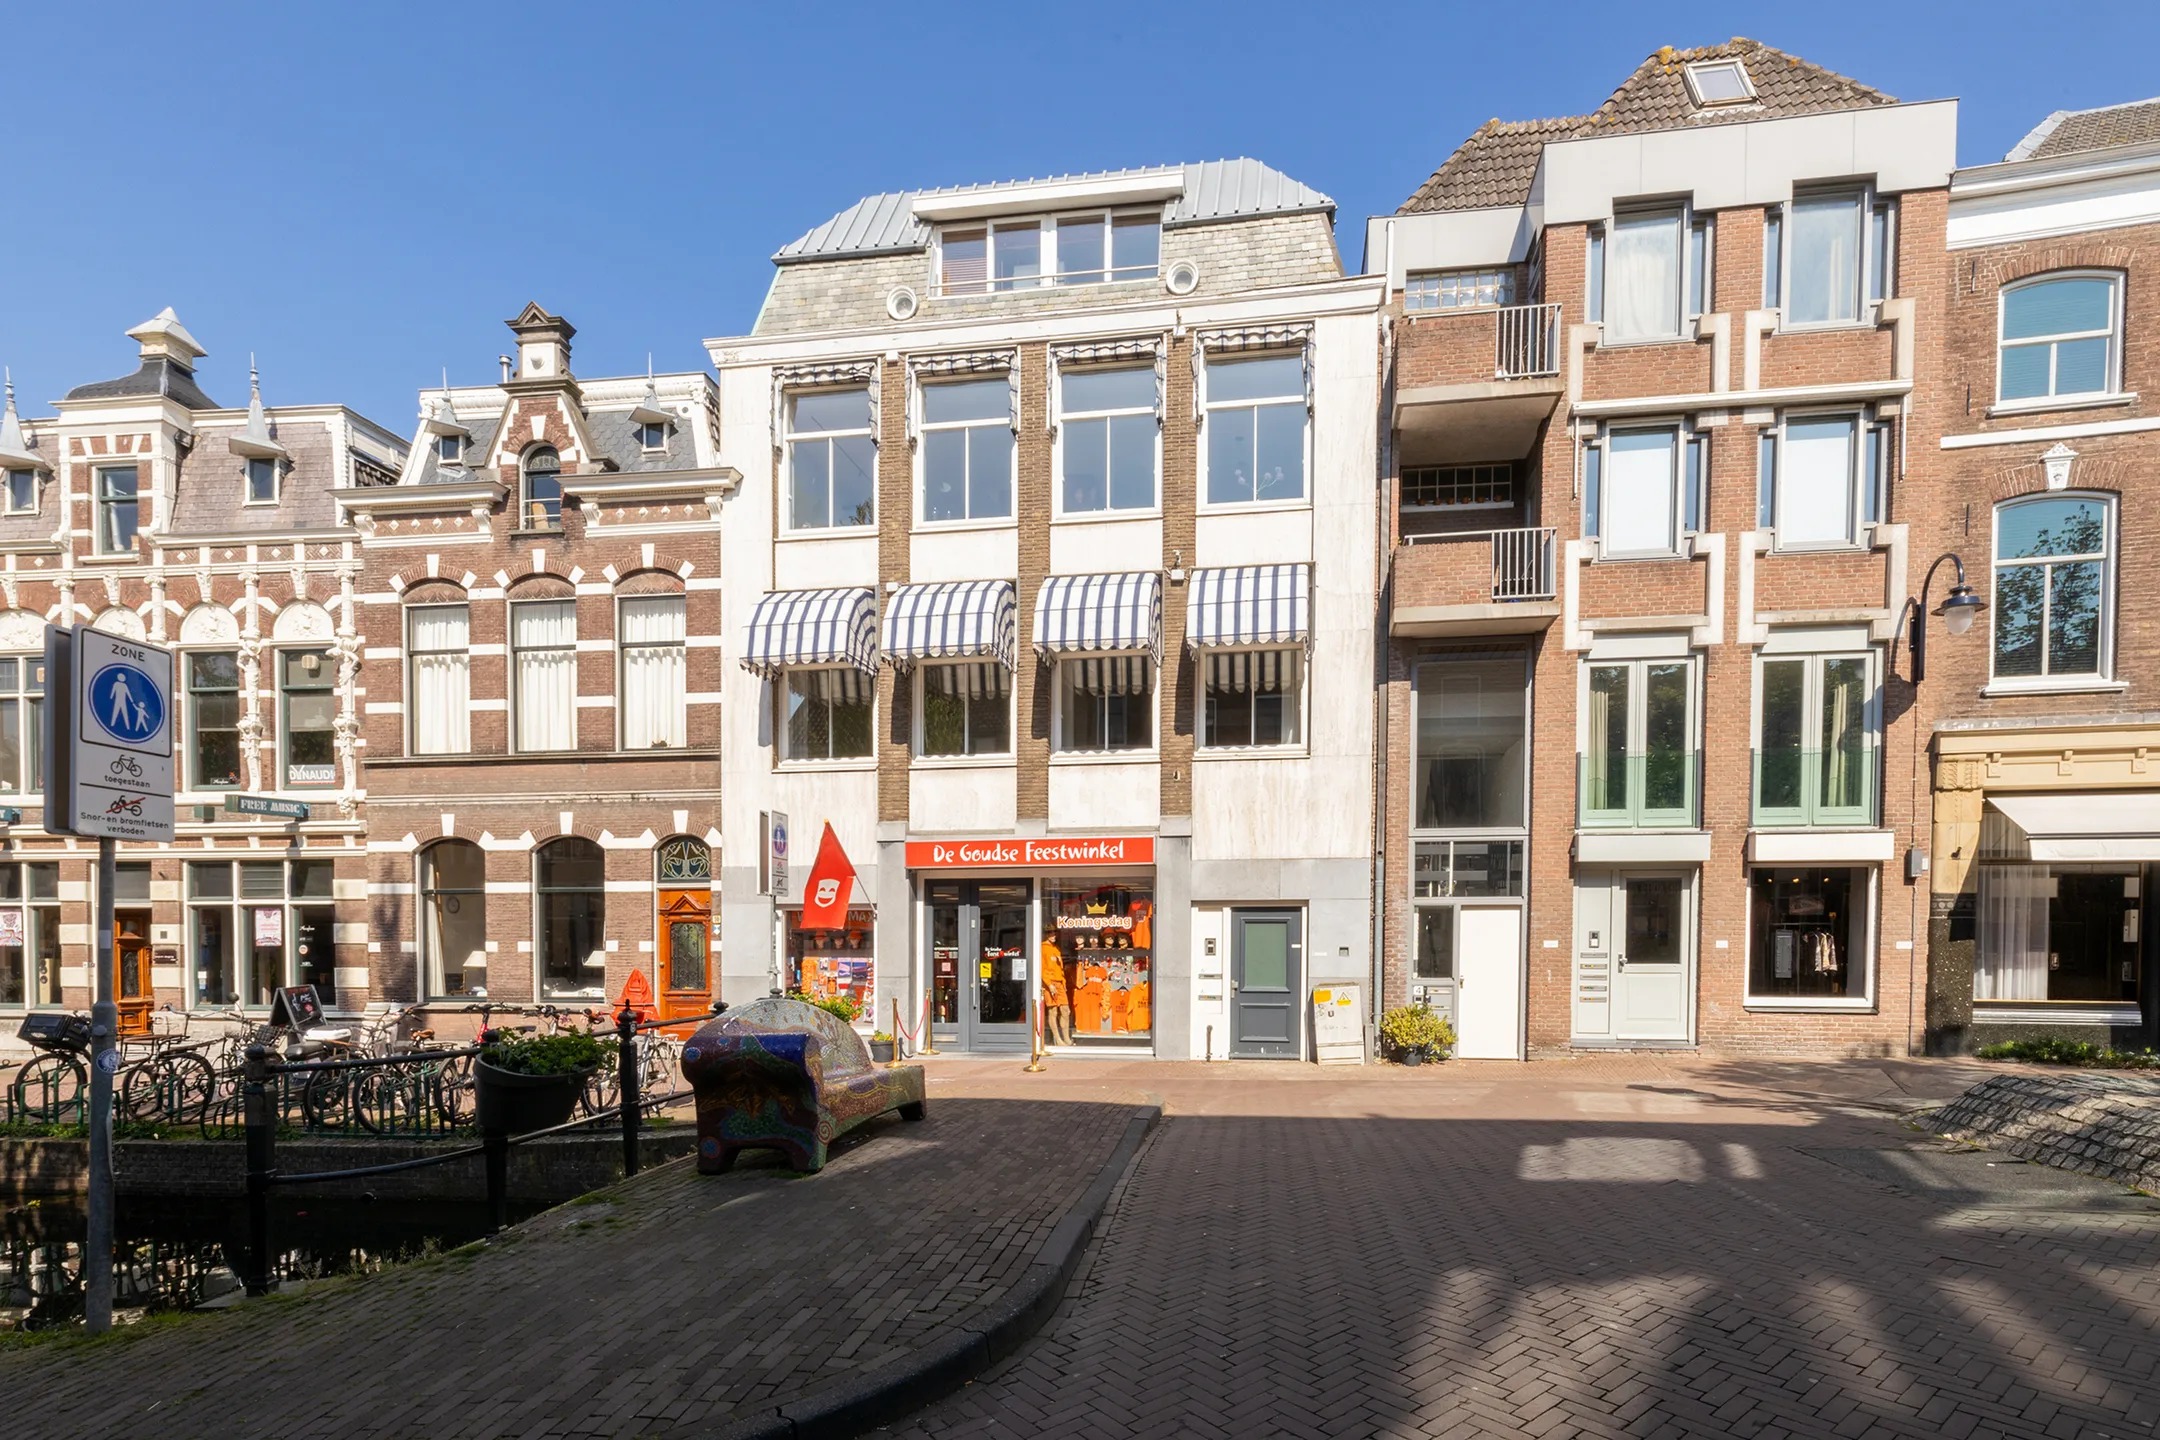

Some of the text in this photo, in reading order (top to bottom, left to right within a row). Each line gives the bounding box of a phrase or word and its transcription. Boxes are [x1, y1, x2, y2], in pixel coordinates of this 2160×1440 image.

[111, 643, 145, 662] ZONE
[289, 765, 335, 780] DYNAUDI
[104, 774, 150, 788] toegestaan
[240, 799, 300, 814] FREE MUSIC
[106, 825, 145, 835] verboden
[120, 817, 169, 829] bromfietsen
[933, 840, 1124, 863] De Goudse Feestwinkel
[1057, 914, 1132, 930] Koningsdag
